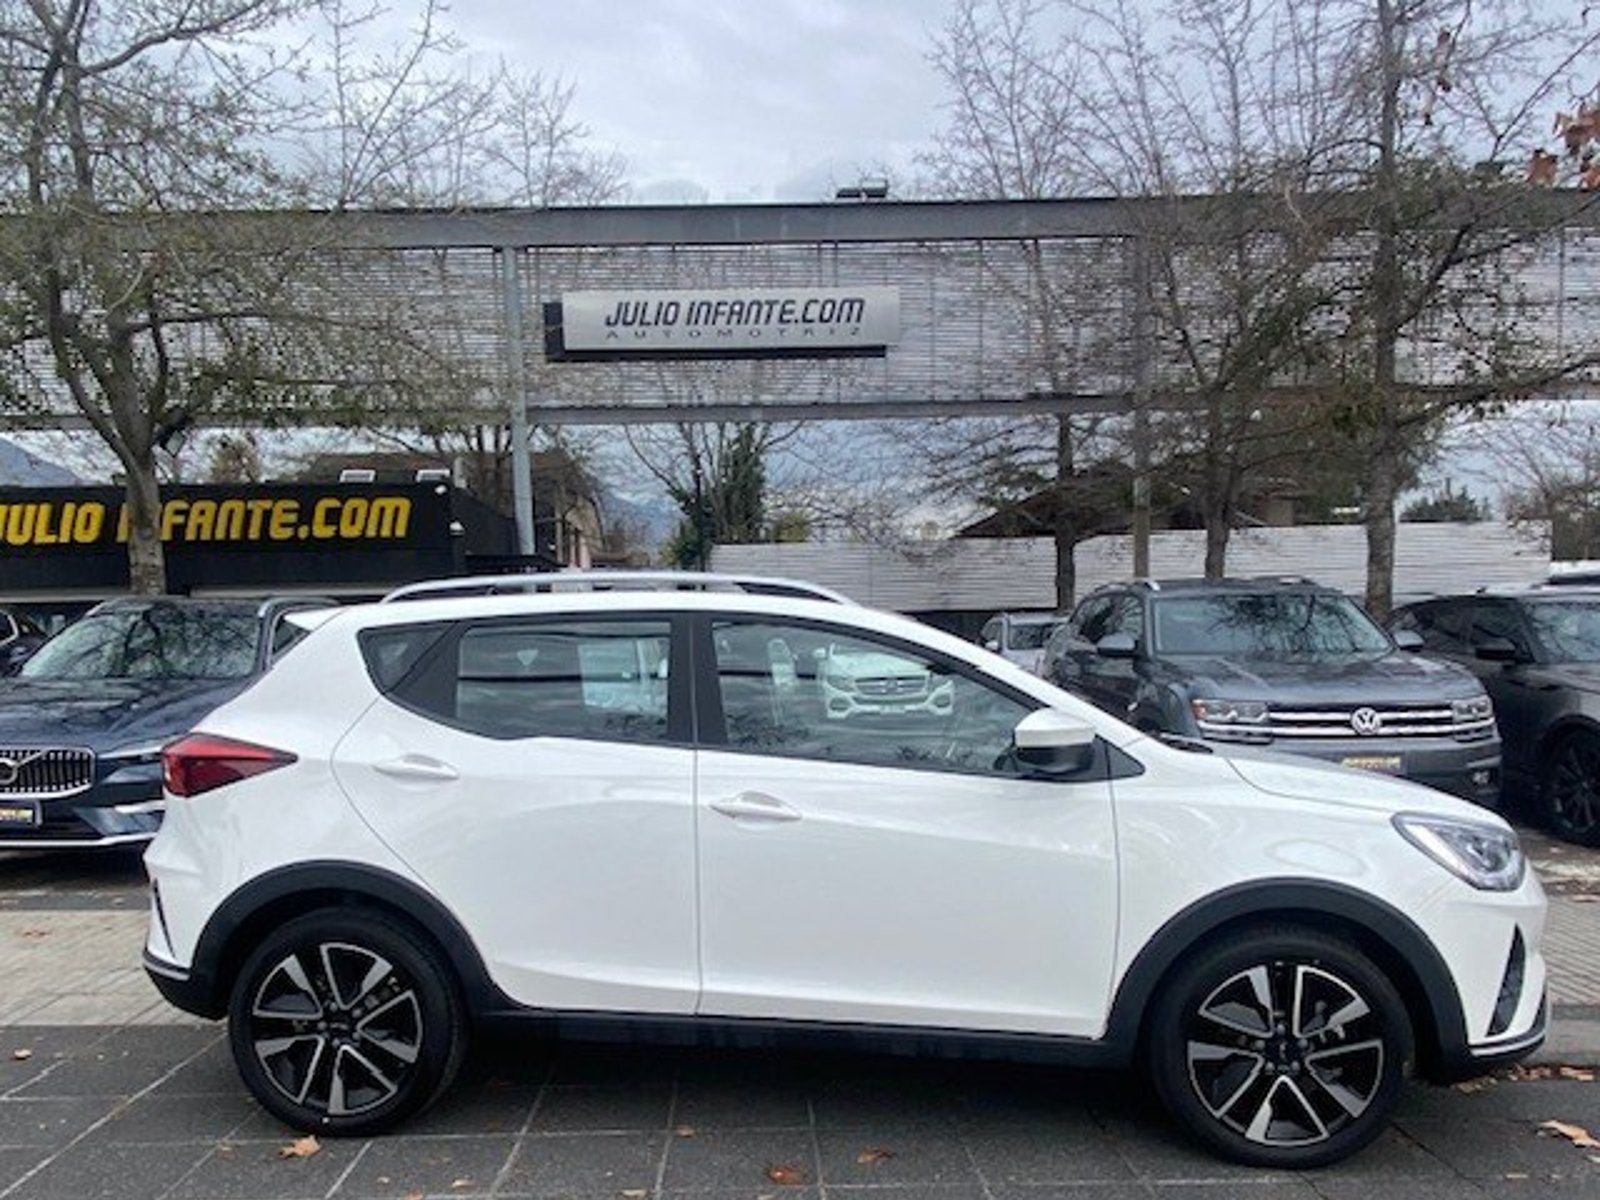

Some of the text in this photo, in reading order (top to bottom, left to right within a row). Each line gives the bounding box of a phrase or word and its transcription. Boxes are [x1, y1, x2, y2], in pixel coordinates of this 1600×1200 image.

[605, 298, 864, 327] JULIO INFANTE.COM
[605, 326, 861, 340] AUTOMOTRIZ
[116, 497, 411, 542] IFANTE.COM
